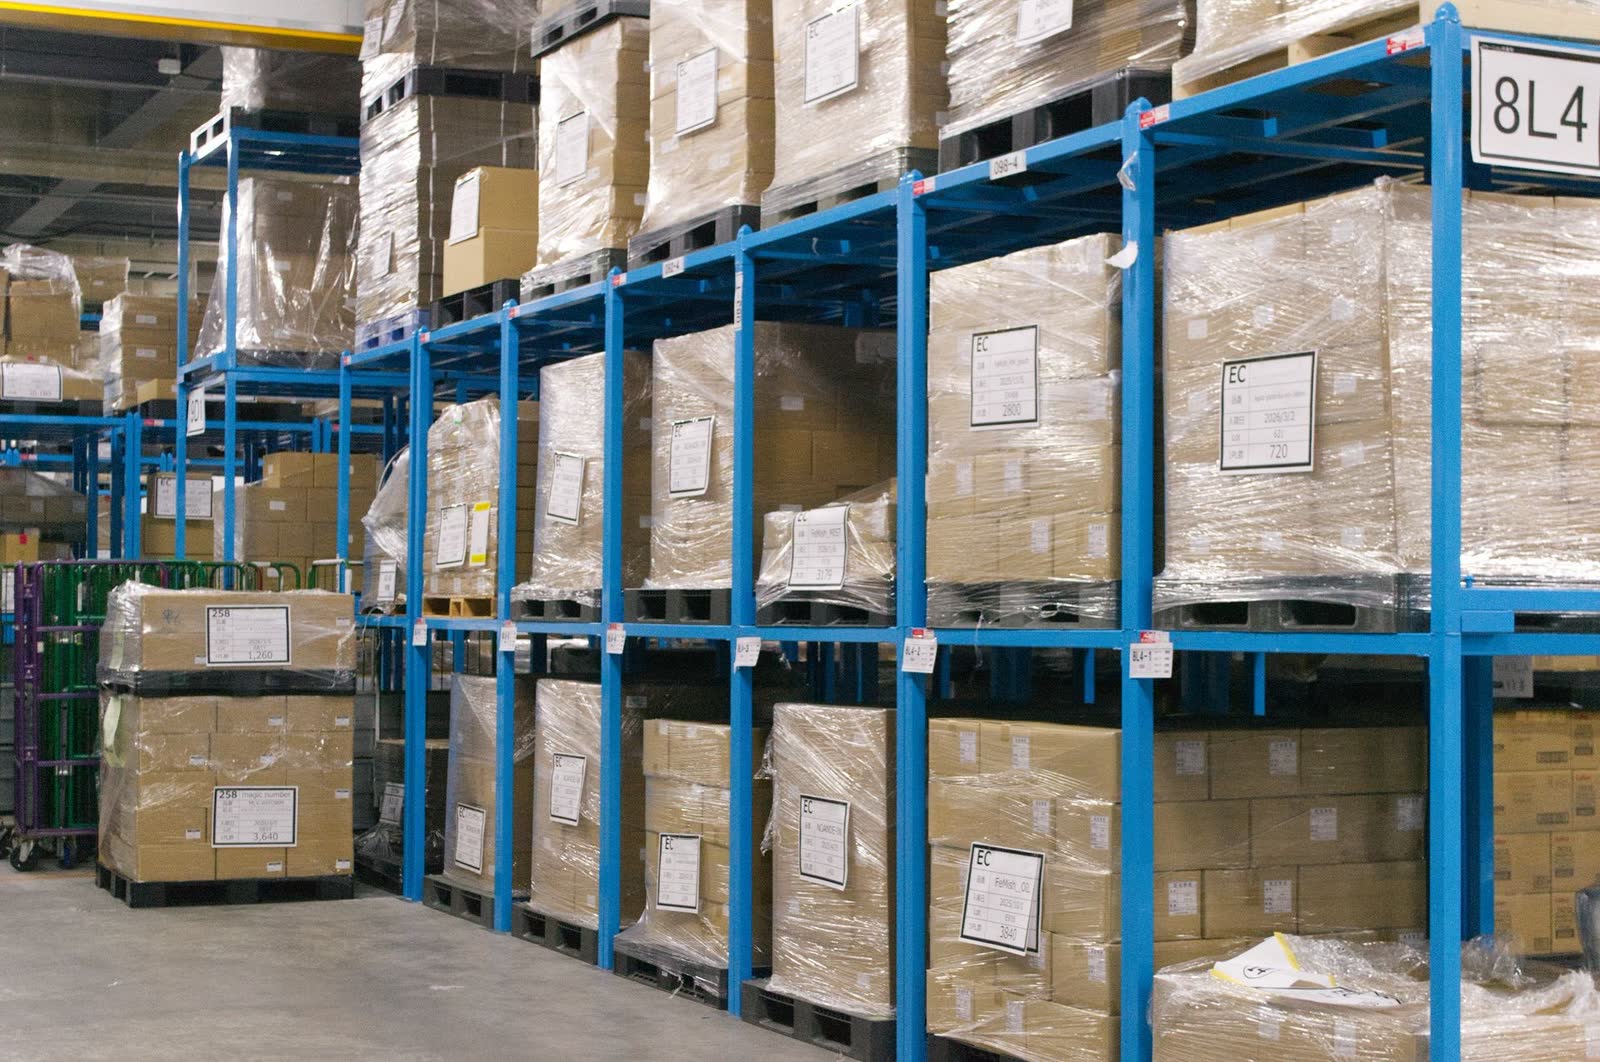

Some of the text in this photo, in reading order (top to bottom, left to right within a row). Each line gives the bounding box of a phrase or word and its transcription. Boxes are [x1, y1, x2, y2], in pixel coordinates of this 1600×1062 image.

[1493, 76, 1588, 142] 8L4
[977, 336, 989, 352] EC
[1229, 365, 1247, 384] EC
[1002, 402, 1022, 417] 2800
[1270, 444, 1288, 459] 720
[212, 609, 231, 618] 258
[248, 651, 273, 661] 1,260
[219, 790, 238, 799] 258
[241, 792, 262, 800] magic
[804, 799, 813, 814] EC
[254, 832, 279, 842] 3,640
[665, 837, 674, 850] EC
[977, 850, 991, 866] EC
[1000, 925, 1018, 941] 3840
